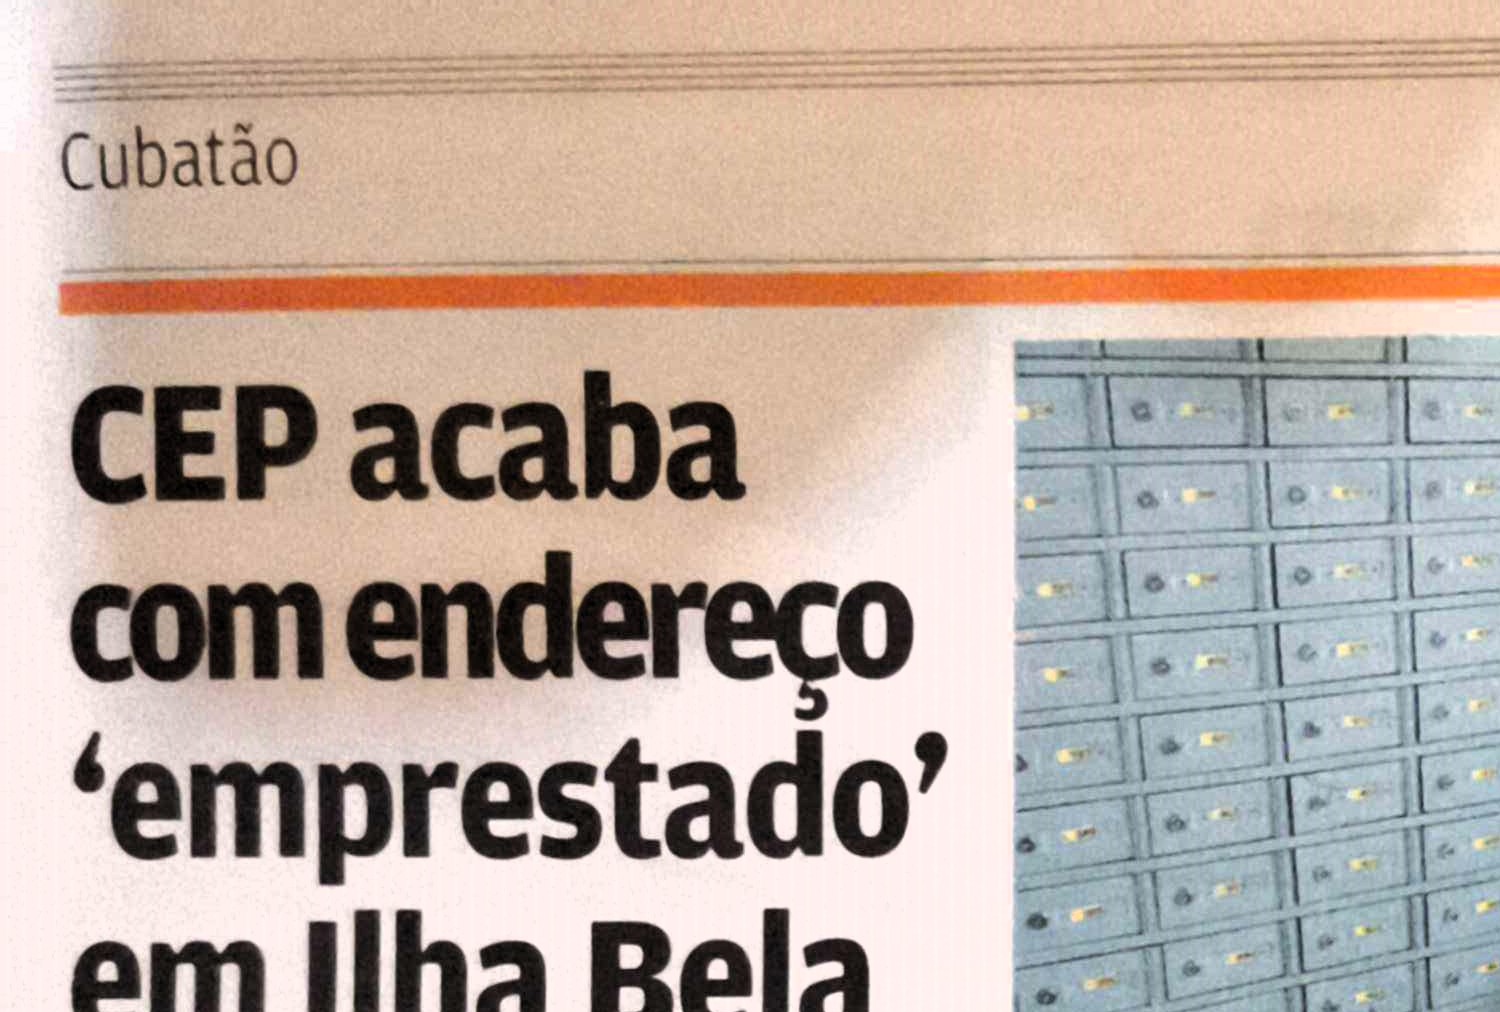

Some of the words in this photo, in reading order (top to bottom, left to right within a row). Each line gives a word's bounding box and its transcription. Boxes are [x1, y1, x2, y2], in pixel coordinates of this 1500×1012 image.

[61, 122, 298, 191] Cubatão
[70, 384, 318, 505] CEP
[349, 369, 747, 502] acaba
[70, 581, 324, 683] com
[345, 550, 914, 720] endereço
